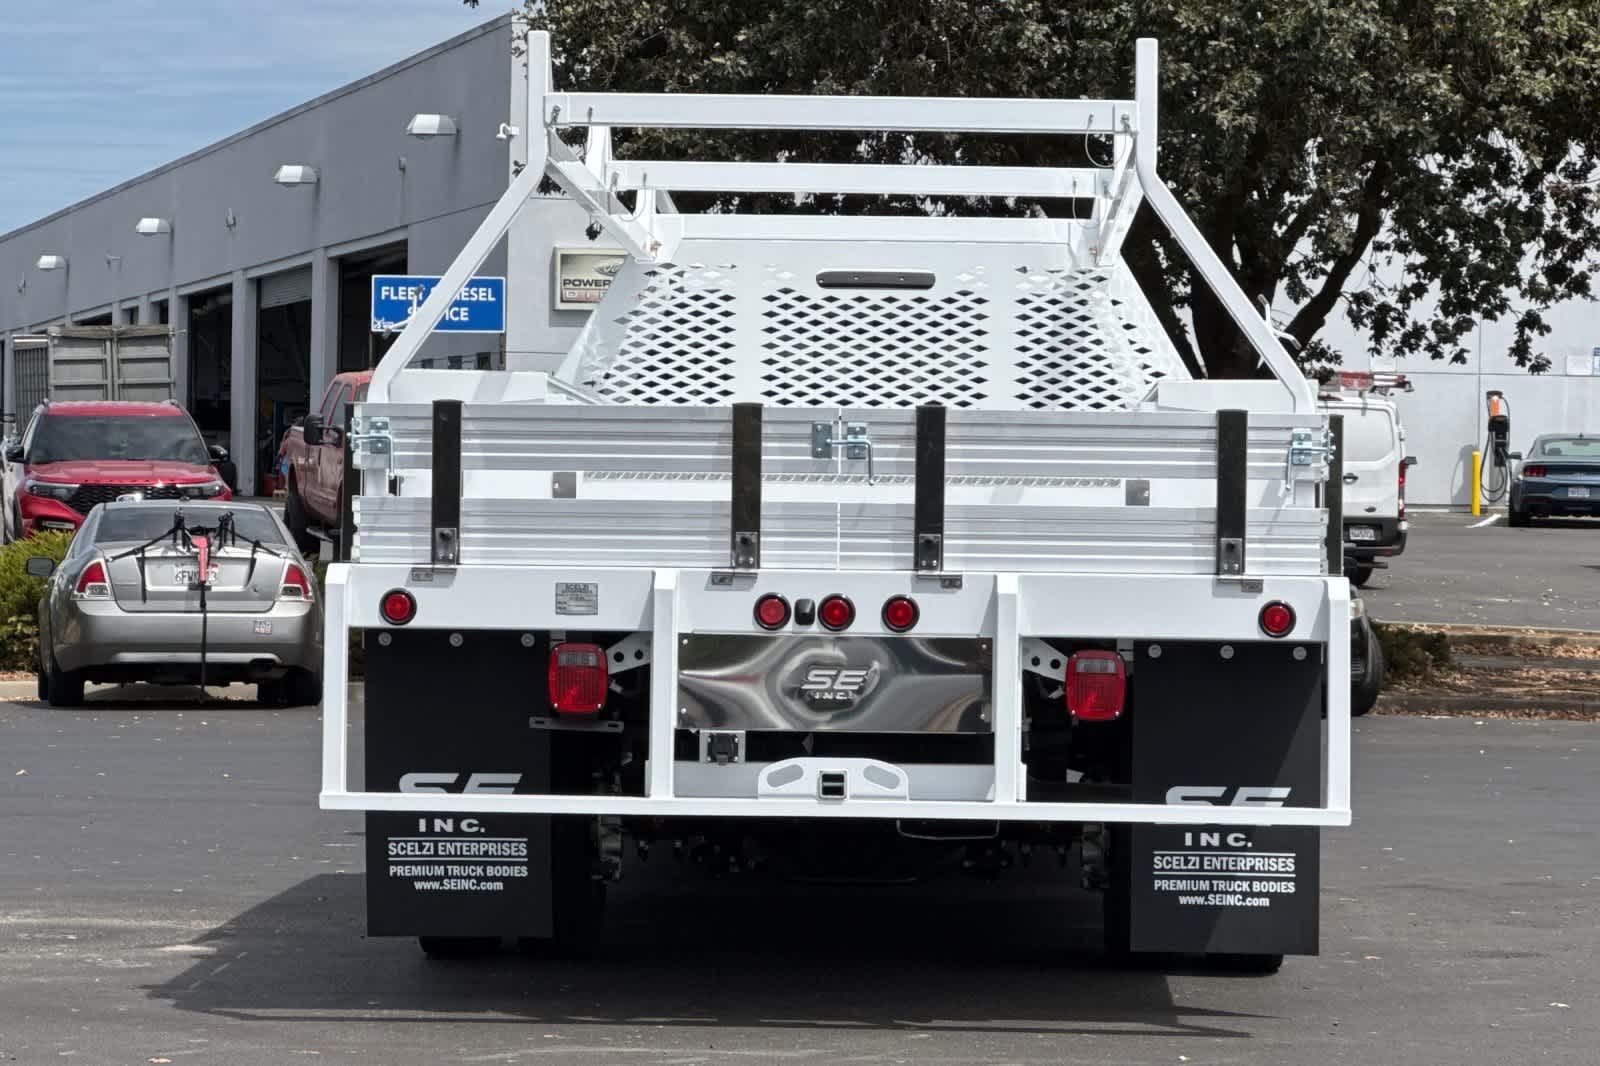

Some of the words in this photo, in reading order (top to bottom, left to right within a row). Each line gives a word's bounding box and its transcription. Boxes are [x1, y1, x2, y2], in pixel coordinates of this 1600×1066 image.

[456, 287, 496, 302] IESEL
[801, 669, 867, 690] SE
[418, 818, 486, 833] INC.
[1184, 832, 1253, 848] INC.
[388, 842, 434, 856] SCELZI
[438, 842, 527, 856] ENTERPRISES
[389, 865, 445, 877] PREMIUM
[446, 865, 484, 877] TRUCK
[486, 866, 528, 878] BODIES
[1153, 856, 1200, 870] SCELZI
[1203, 856, 1295, 872] ENTERPRISES
[414, 879, 504, 891] www.SEINC.com
[1154, 879, 1210, 892] PREMIUM
[1211, 880, 1250, 893] TRUCK
[1252, 881, 1296, 894] BODIES
[1178, 894, 1270, 907] www.SEINC.com
